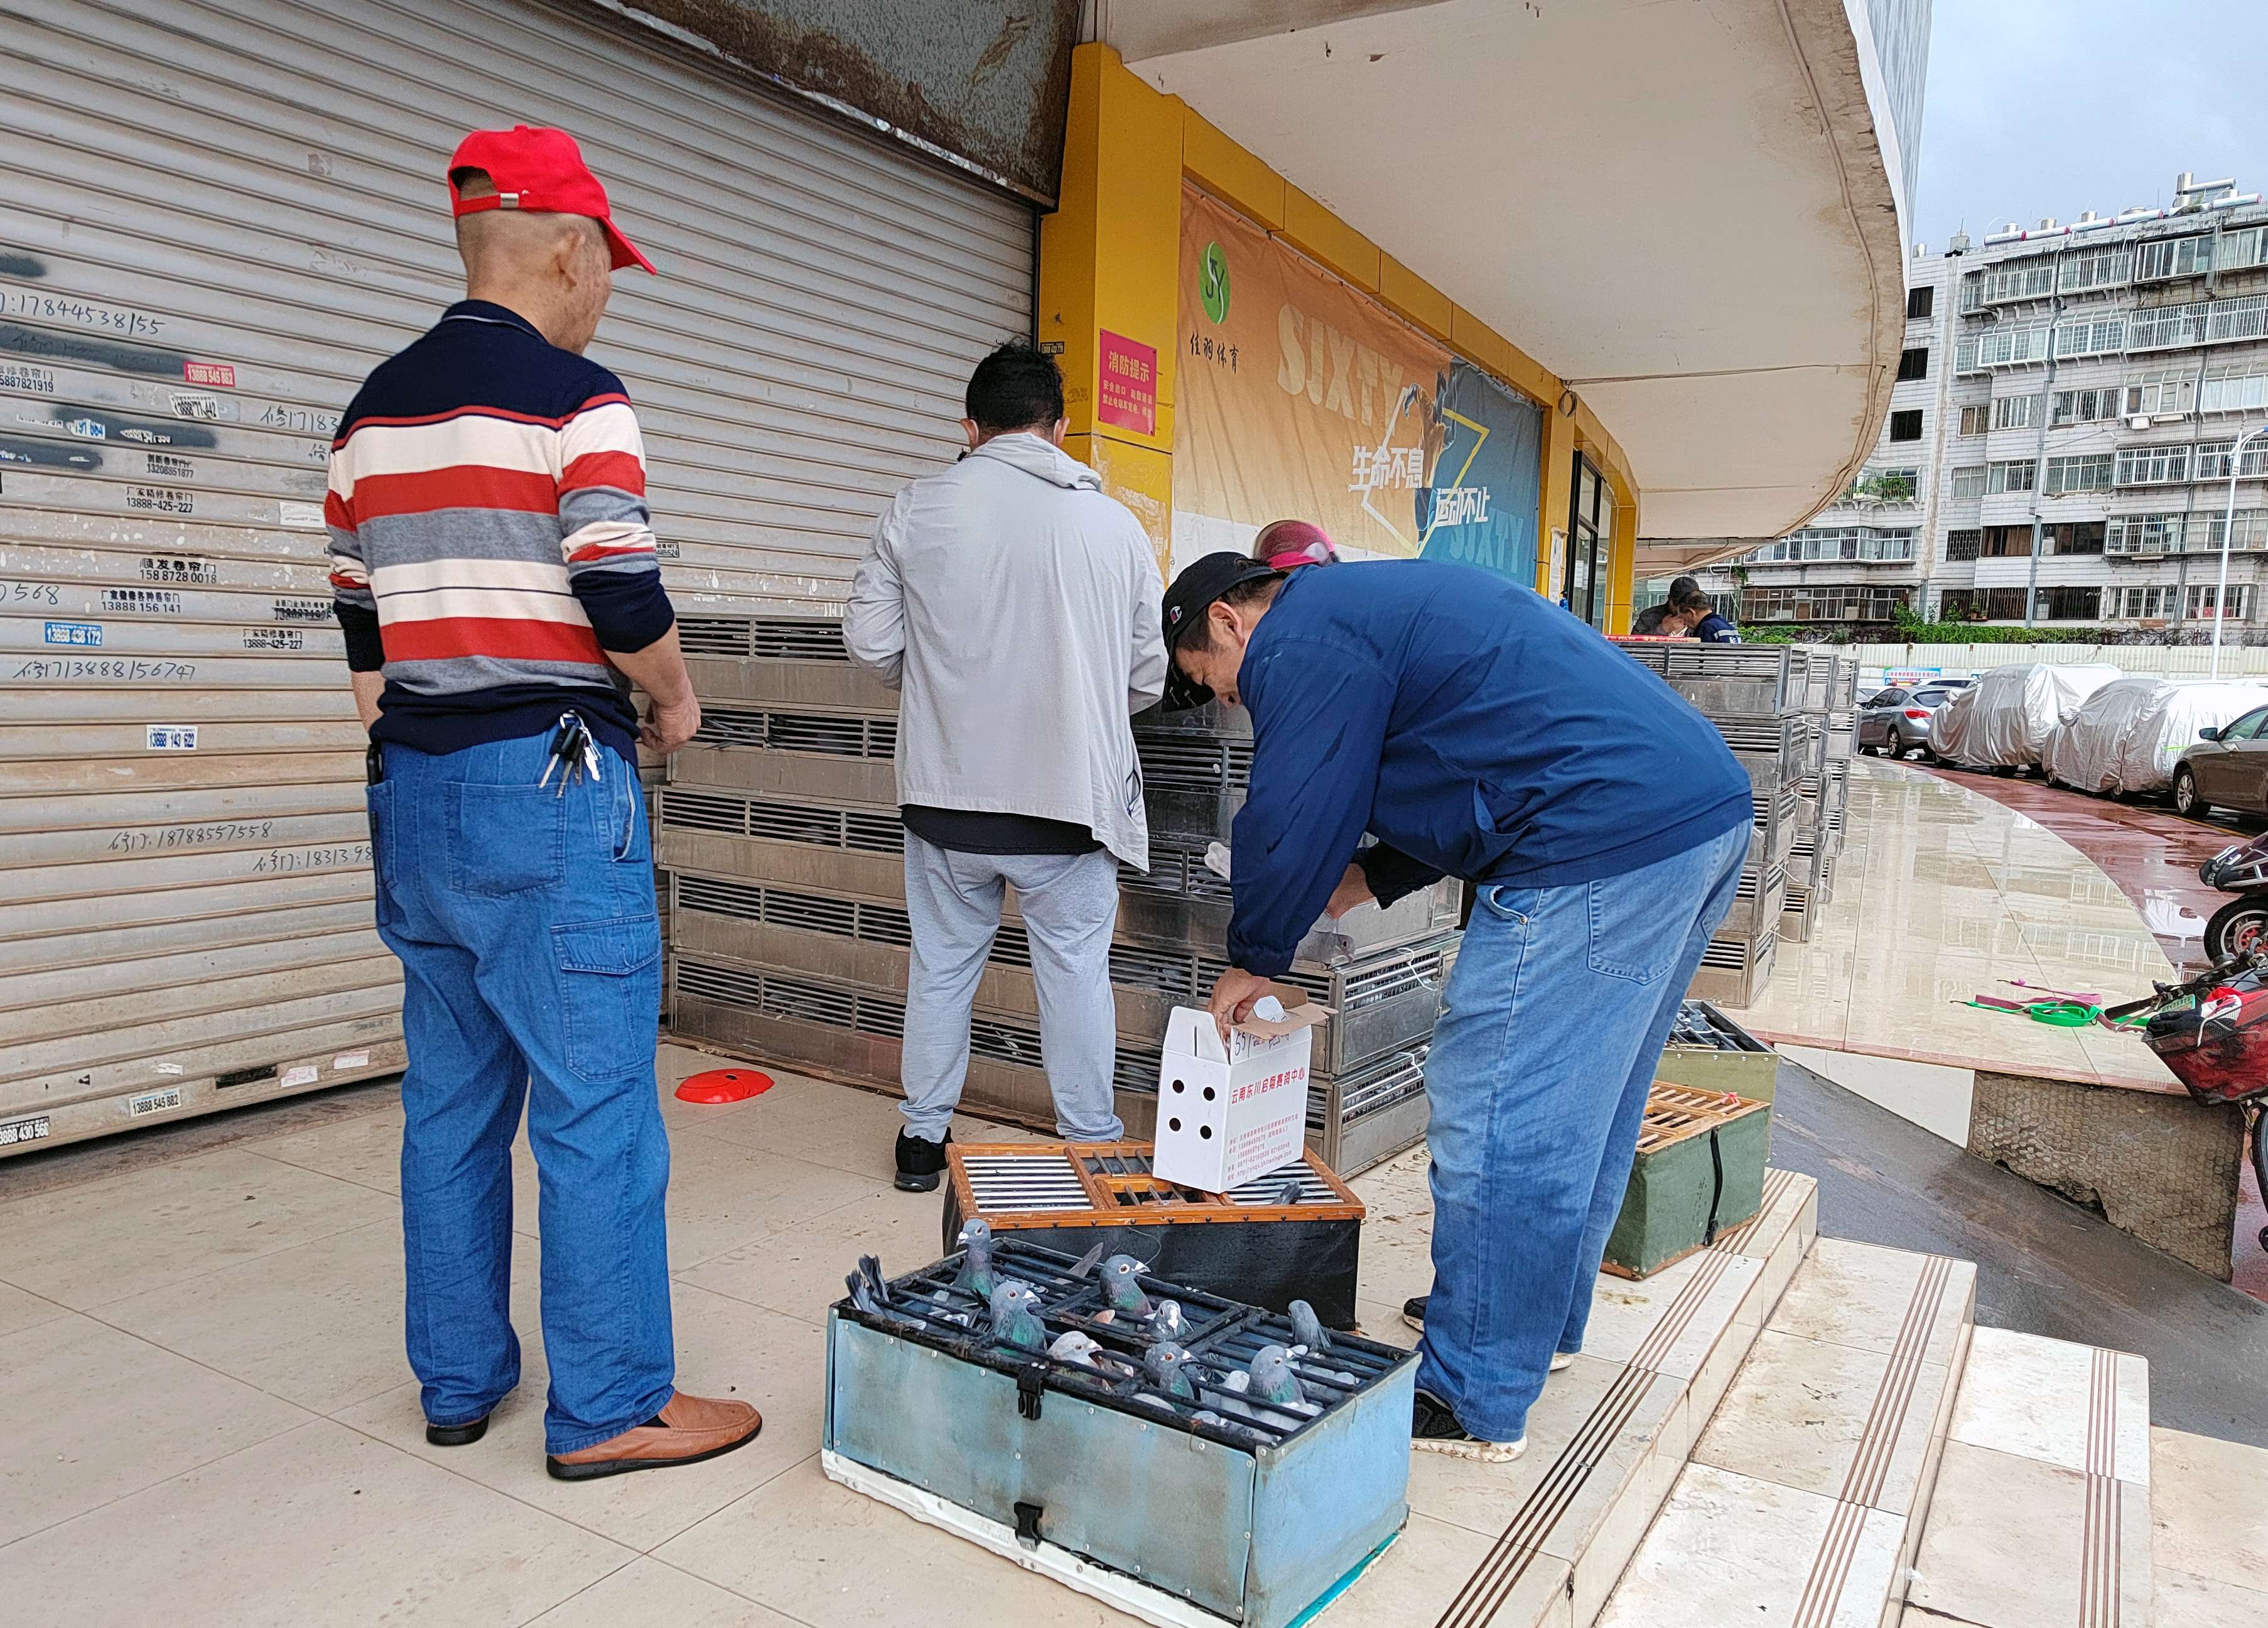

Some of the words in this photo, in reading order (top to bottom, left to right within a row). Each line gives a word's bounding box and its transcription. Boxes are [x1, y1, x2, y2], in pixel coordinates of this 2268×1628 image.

[1108, 350, 1150, 383] 消防提示
[1103, 379, 1126, 396] 安全出口
[1348, 445, 1424, 492] 生命不息
[126, 497, 193, 514] 13888-425-227
[1434, 486, 1491, 528] 运动不止
[139, 558, 217, 574] 顺发卷帘门
[139, 569, 159, 580] 158
[190, 572, 217, 584] 0018
[101, 601, 136, 612] 13888
[139, 602, 159, 612] 156
[163, 604, 181, 614] 141
[47, 627, 70, 643] 13888
[87, 630, 101, 645] 172
[242, 639, 303, 649] 13888-425-227
[149, 732, 167, 747] 13888
[170, 732, 181, 747] 143
[183, 733, 195, 747] 622
[132, 1100, 153, 1115] 13888
[153, 1097, 166, 1110] 545
[166, 1094, 179, 1107] 882
[19, 1124, 34, 1141] 430
